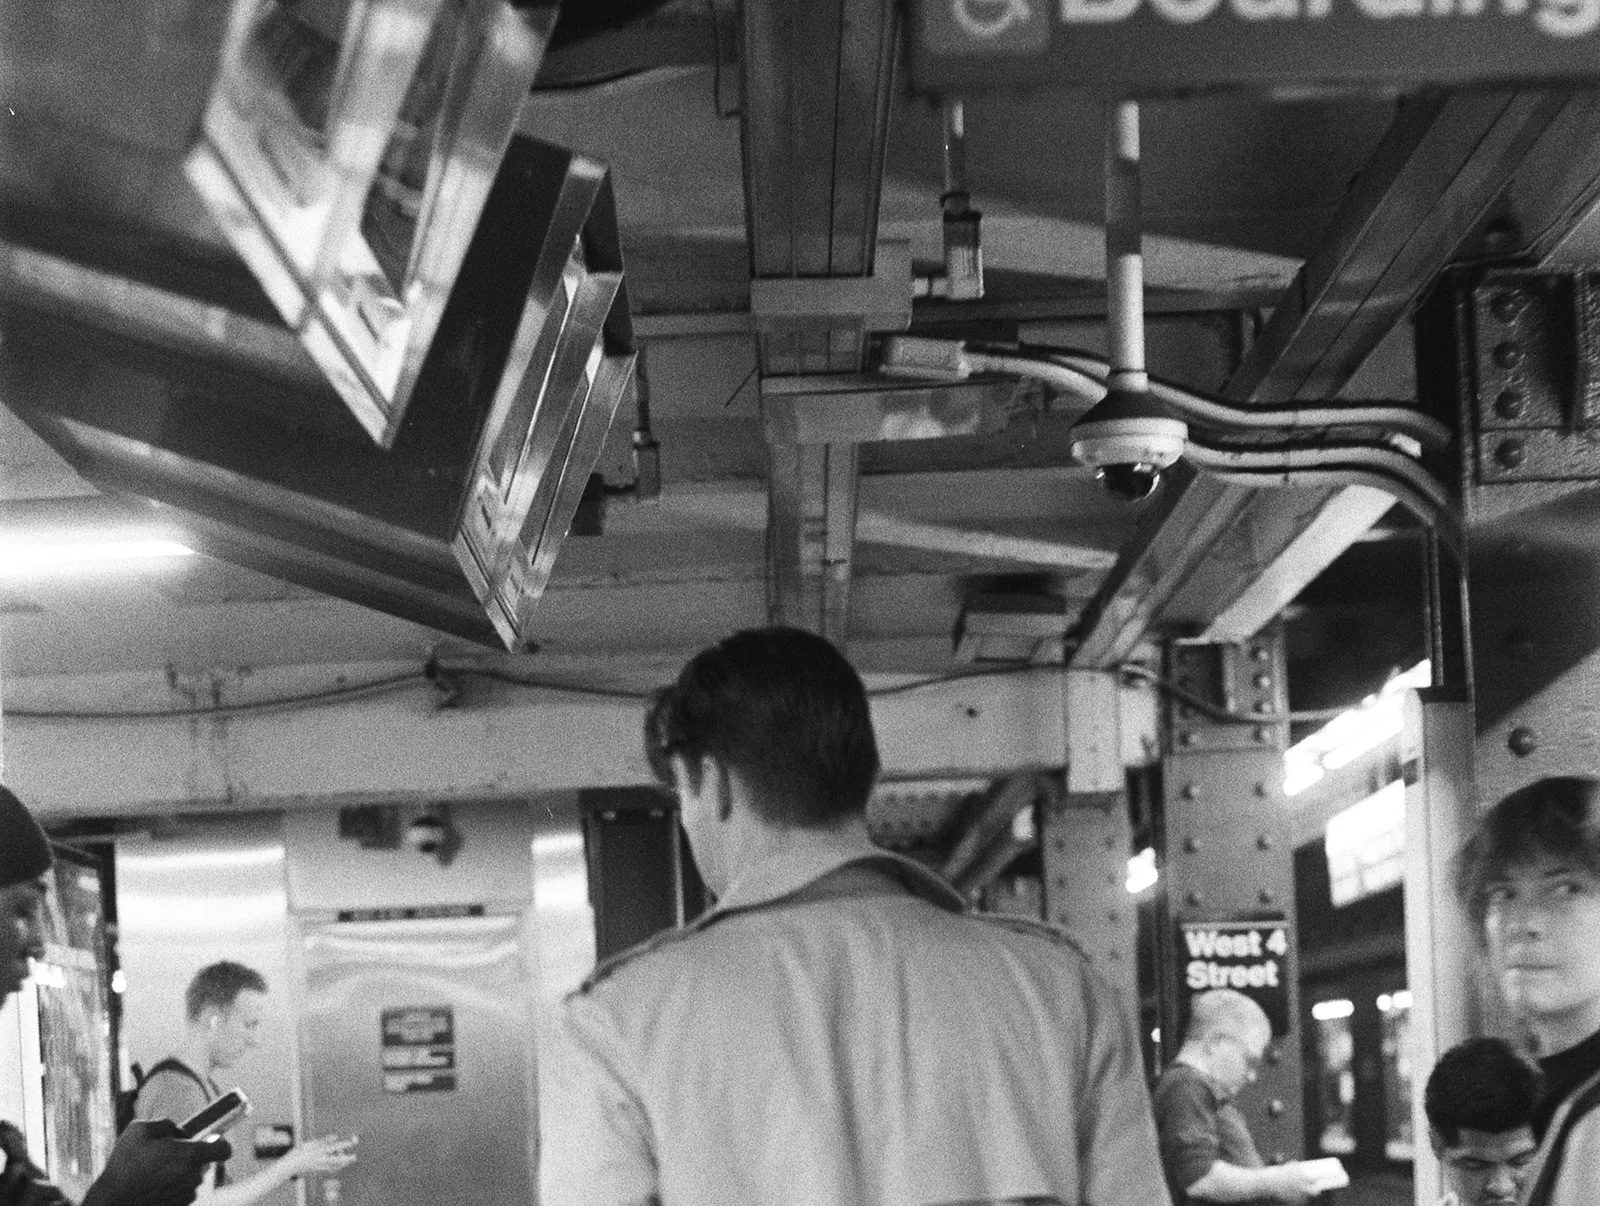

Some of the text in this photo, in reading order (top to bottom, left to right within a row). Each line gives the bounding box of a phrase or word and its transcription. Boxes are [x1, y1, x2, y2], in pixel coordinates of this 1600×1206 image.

[1185, 929, 1287, 958] West 4
[1186, 960, 1279, 989] Street
